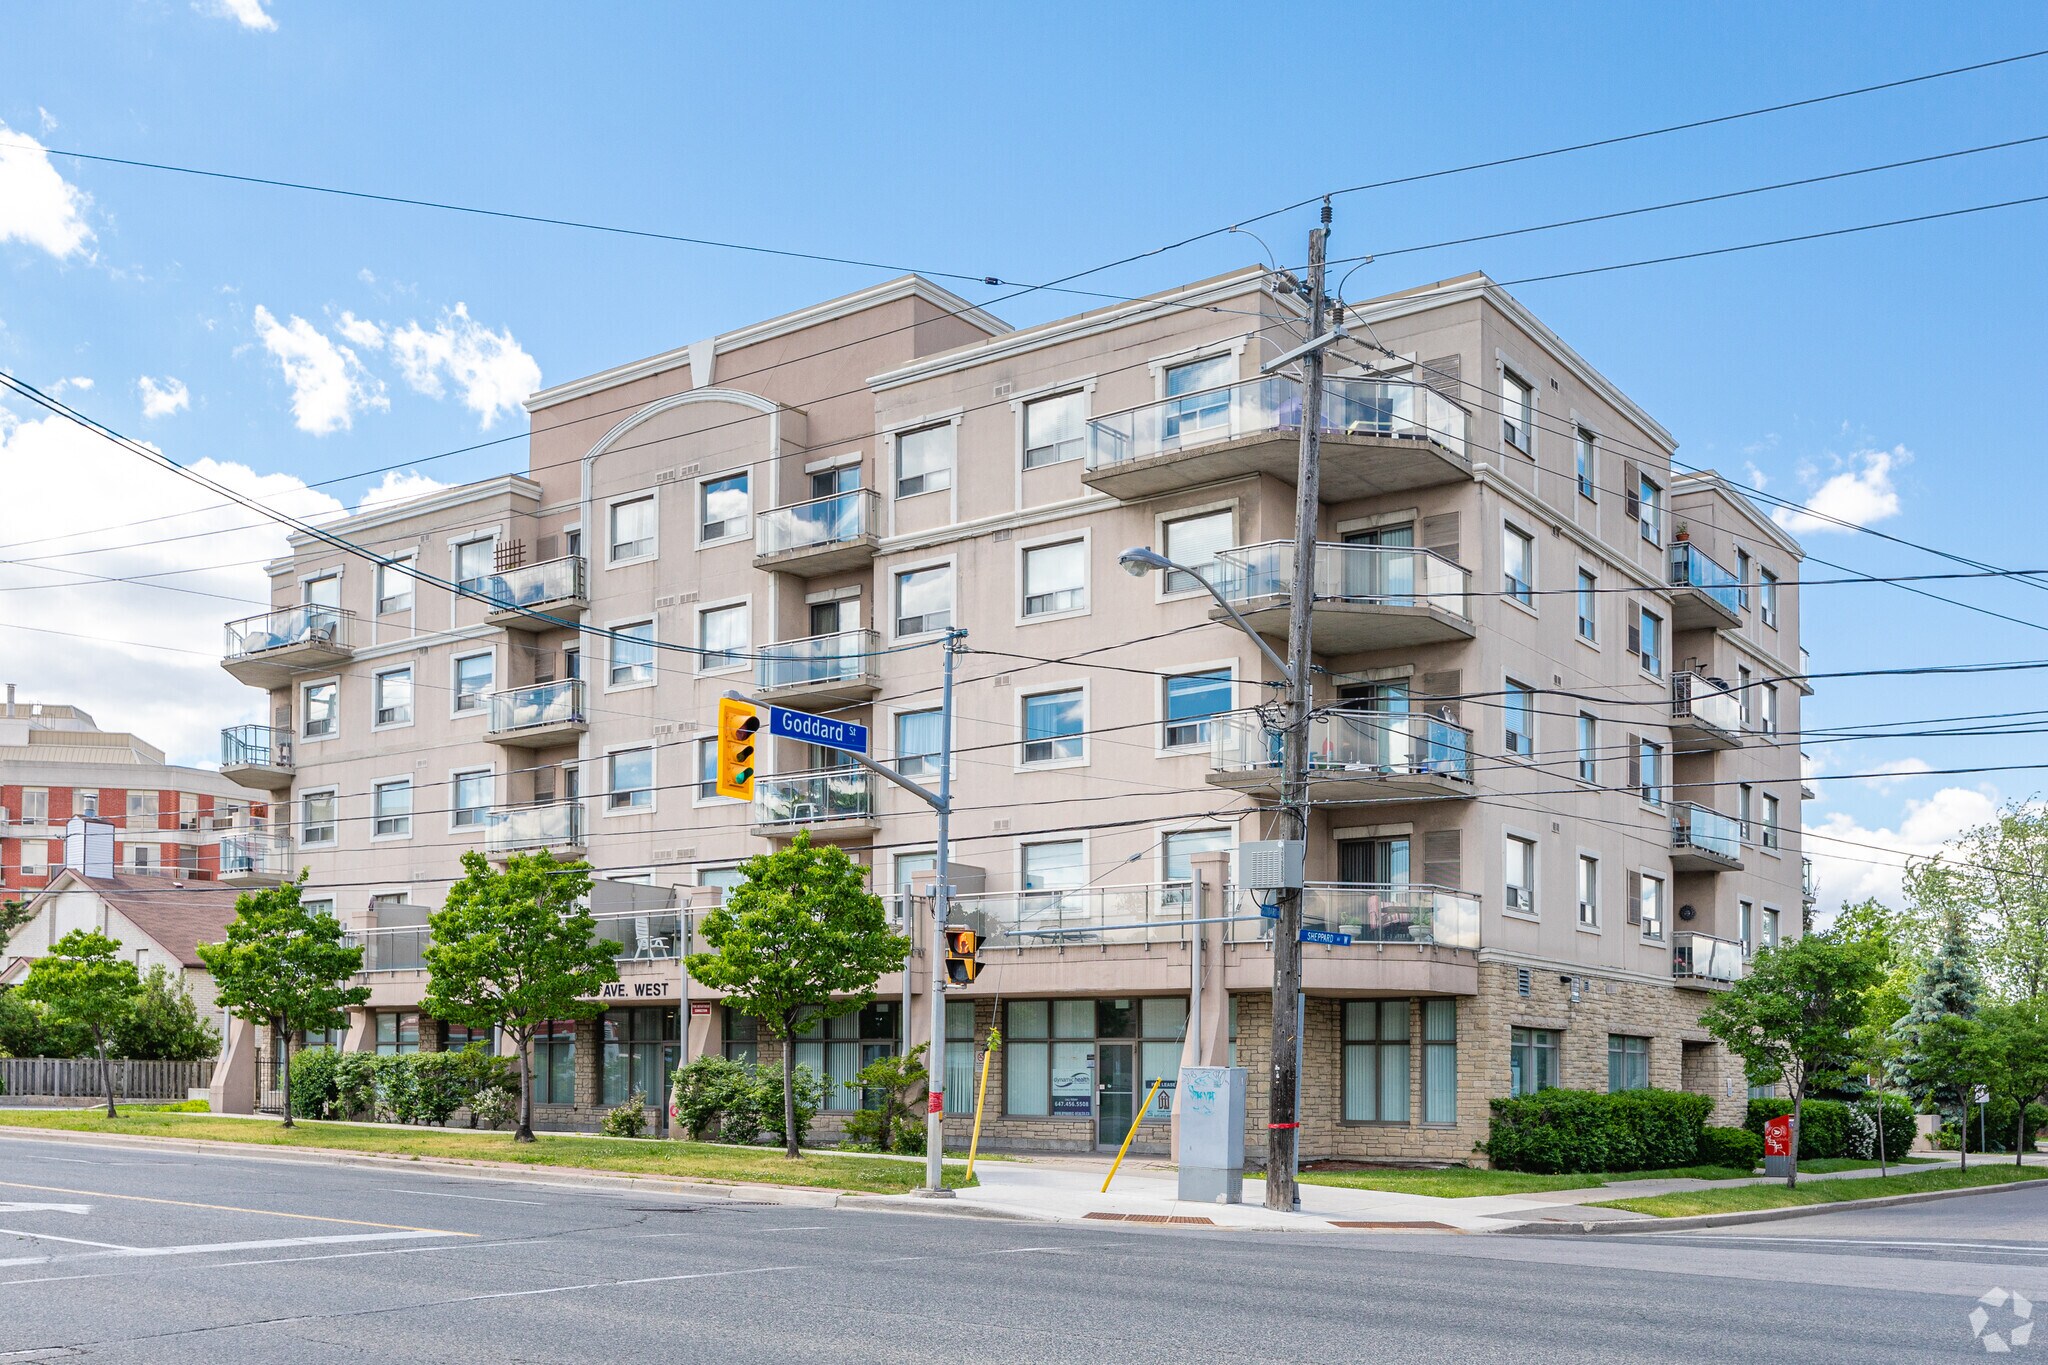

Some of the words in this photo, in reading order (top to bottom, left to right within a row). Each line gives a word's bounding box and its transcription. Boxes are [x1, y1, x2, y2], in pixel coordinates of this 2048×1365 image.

[782, 712, 843, 741] Goddard
[849, 726, 856, 736] St
[1306, 932, 1334, 943] SHEPPARD
[603, 984, 628, 997] AVE.
[634, 983, 669, 997] WEST
